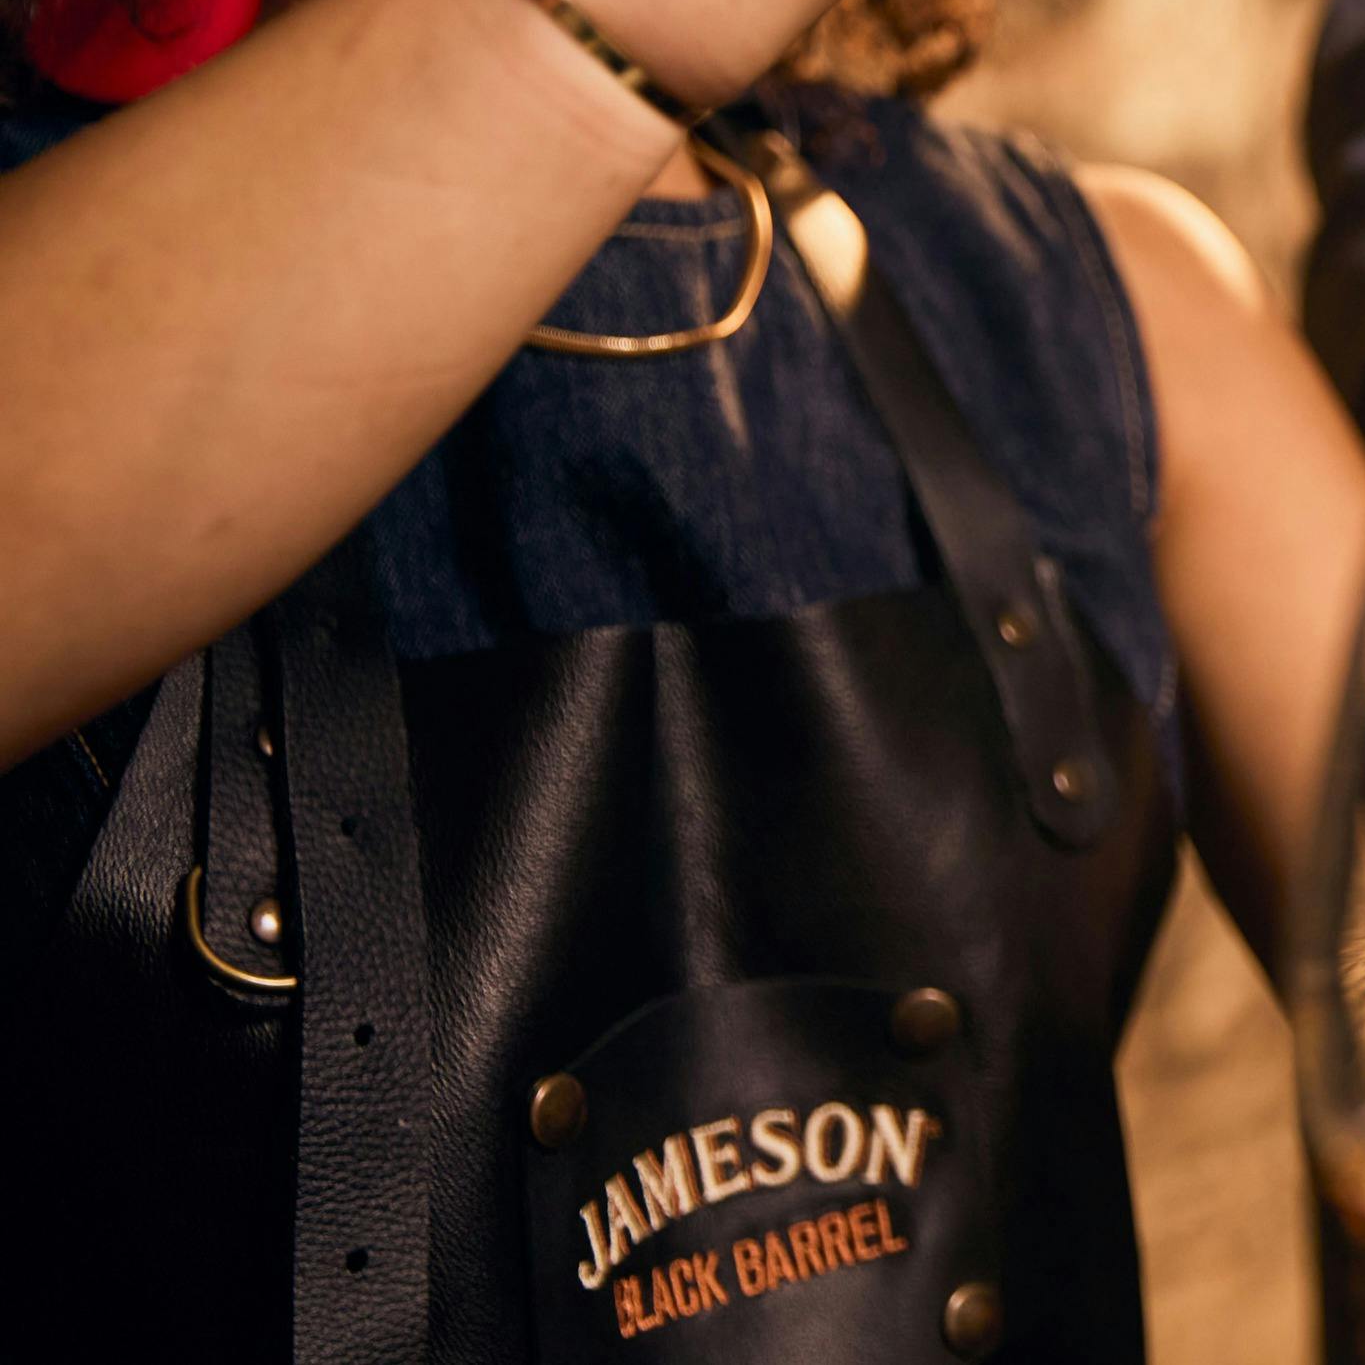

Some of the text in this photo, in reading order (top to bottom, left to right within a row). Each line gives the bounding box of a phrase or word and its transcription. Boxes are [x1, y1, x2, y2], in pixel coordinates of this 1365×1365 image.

[578, 1101, 928, 1291] JAMESON
[612, 1198, 909, 1339] BLACK BARREL
